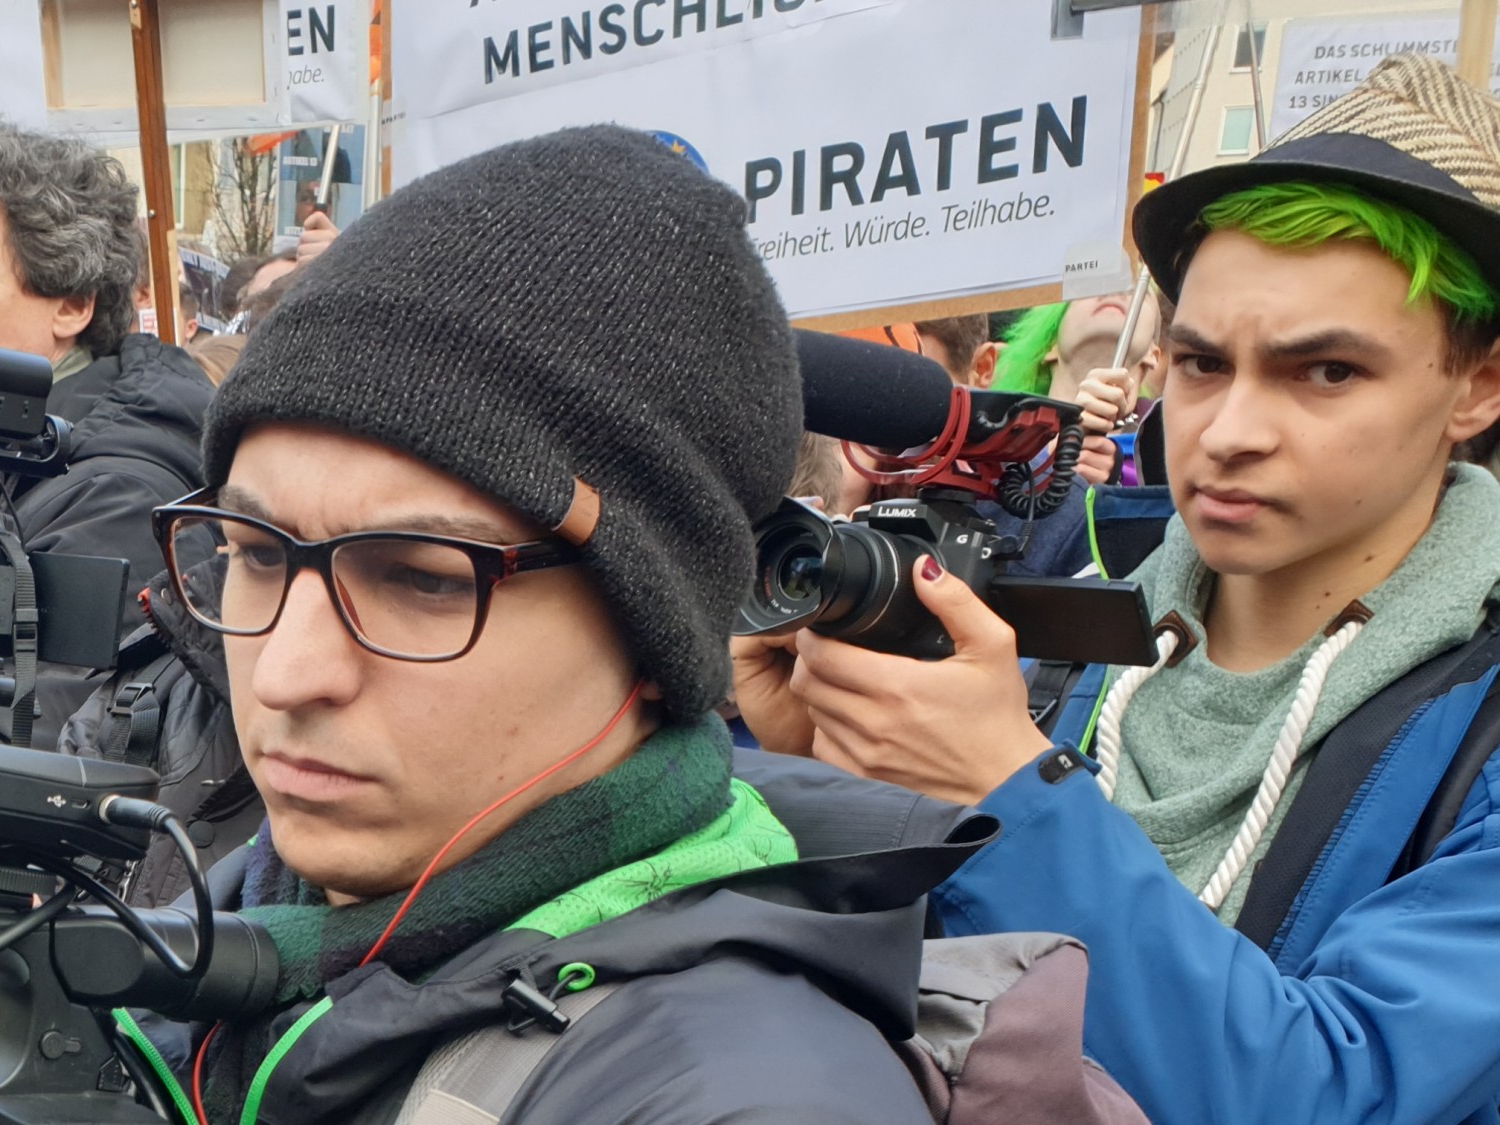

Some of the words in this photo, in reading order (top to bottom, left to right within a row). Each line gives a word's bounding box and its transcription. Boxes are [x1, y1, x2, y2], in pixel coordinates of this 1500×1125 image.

[1314, 44, 1346, 60] DAS
[1288, 96, 1308, 109] 13
[744, 95, 1089, 224] PIRATEN
[751, 226, 834, 262] reiheit.
[845, 211, 930, 248] Würde.
[941, 191, 1056, 234] Teilhabe.
[1065, 260, 1099, 273] PARTEI
[878, 507, 917, 518] LUMIX
